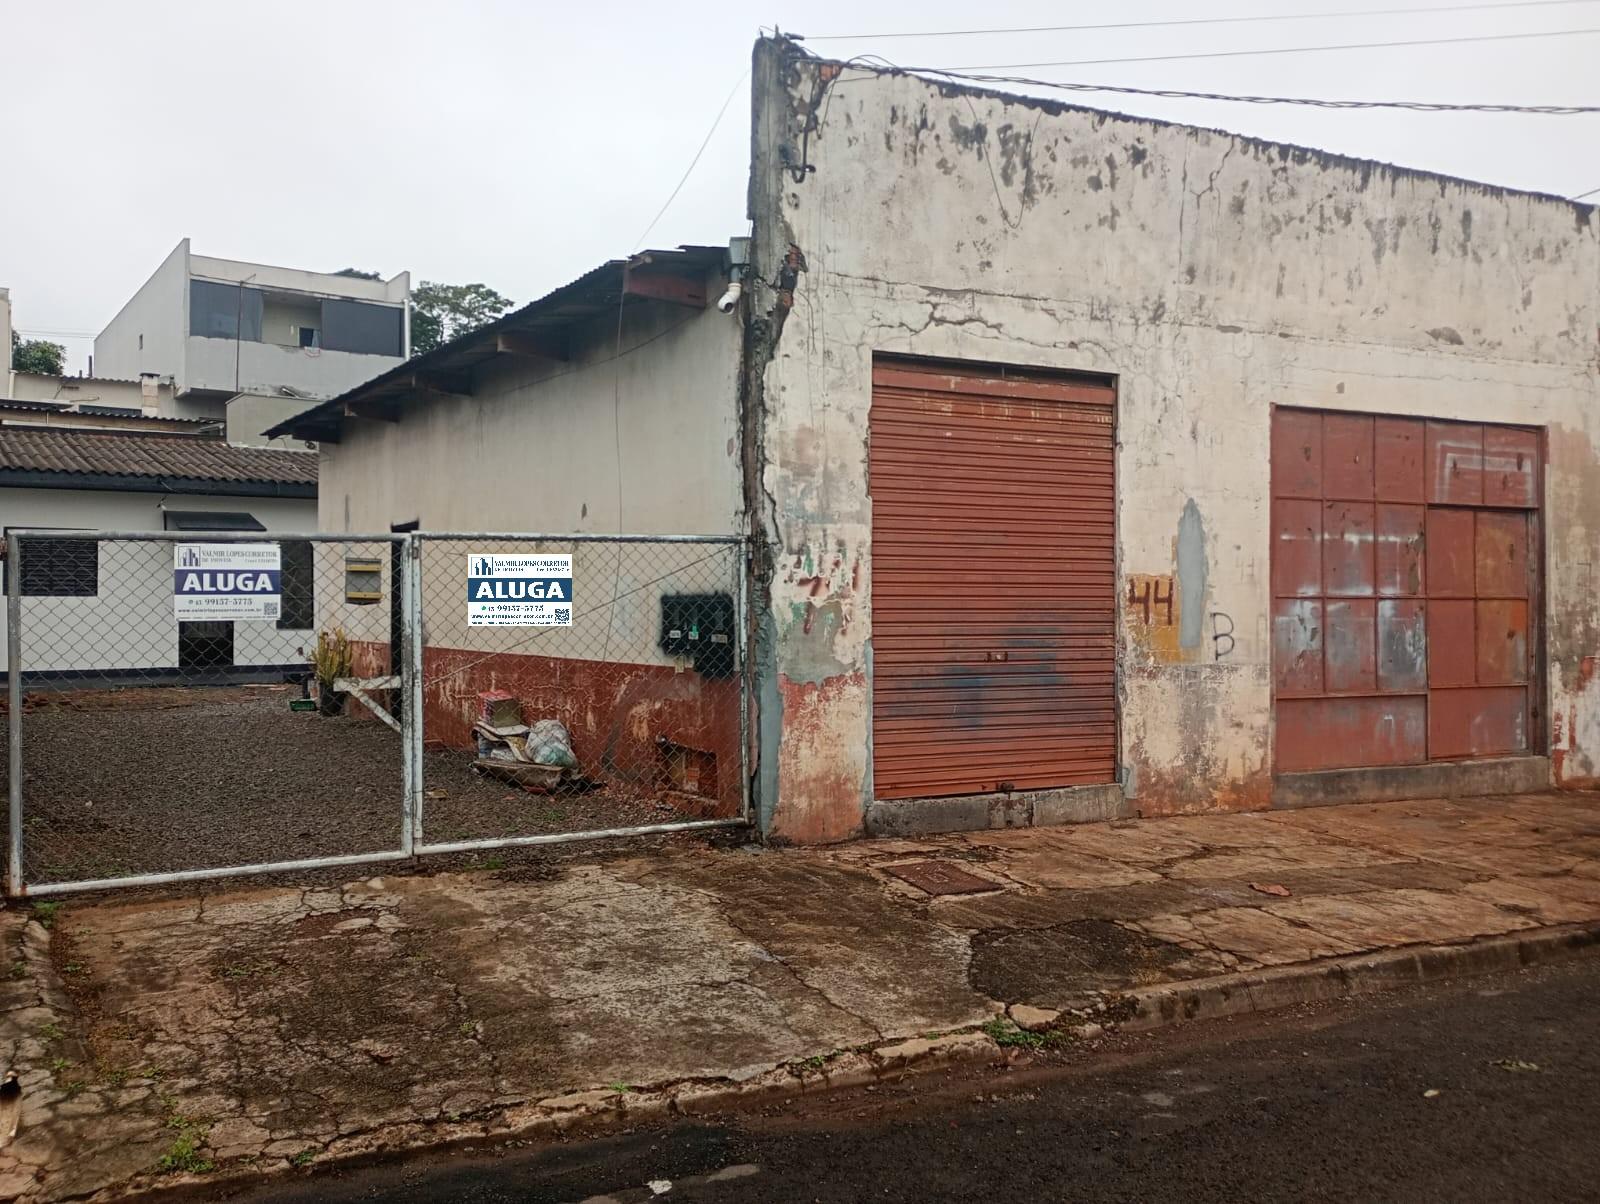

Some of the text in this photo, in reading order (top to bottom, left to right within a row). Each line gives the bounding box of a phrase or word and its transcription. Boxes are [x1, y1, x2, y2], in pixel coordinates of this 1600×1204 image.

[182, 572, 274, 592] ALUGA
[1129, 578, 1174, 626] 44
[1210, 612, 1235, 661] B
